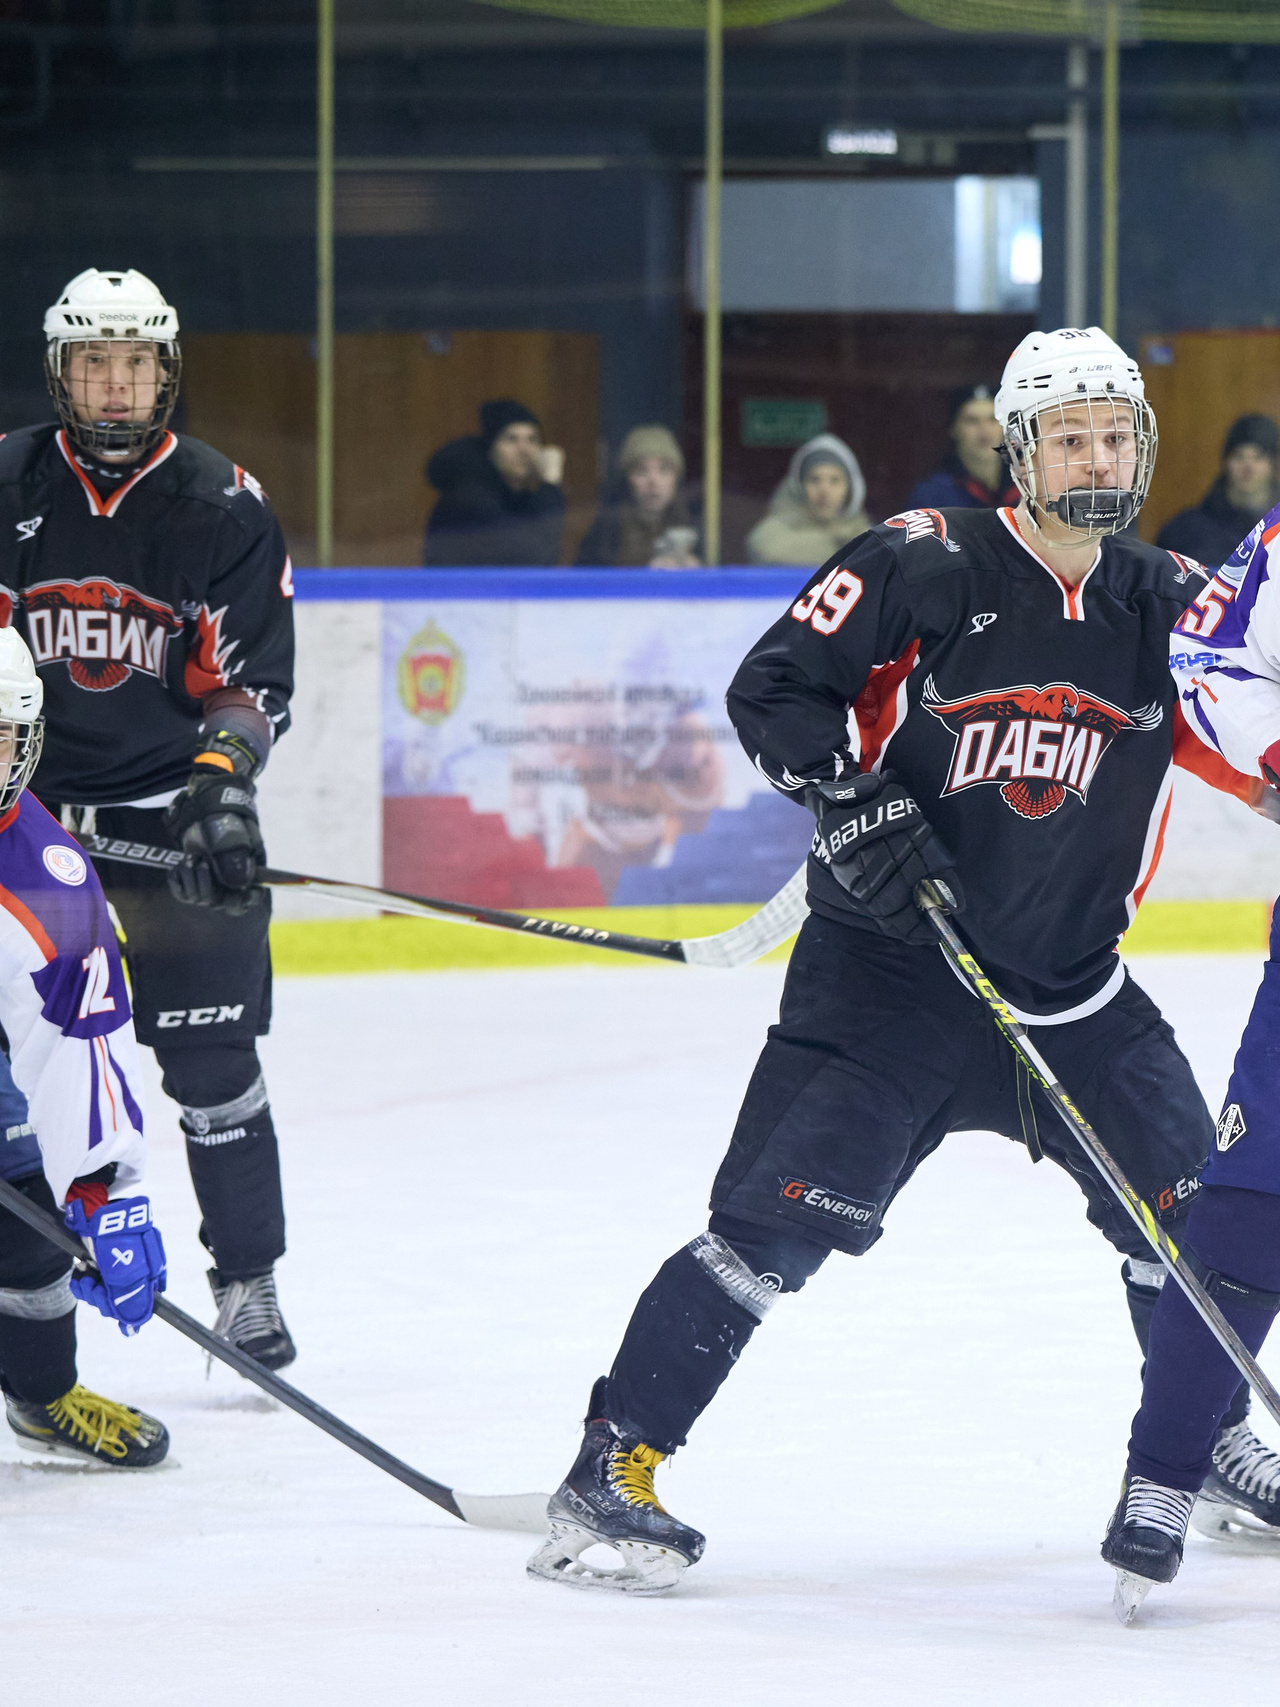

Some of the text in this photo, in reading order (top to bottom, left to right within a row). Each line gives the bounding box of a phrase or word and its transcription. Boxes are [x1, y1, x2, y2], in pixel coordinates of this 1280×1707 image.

[99, 312, 140, 322] Reebok
[829, 798, 922, 855] BAUER
[108, 841, 193, 867] BAUE
[78, 946, 116, 1020] 12
[957, 953, 1020, 1024] CCM
[156, 1003, 245, 1029] CCM
